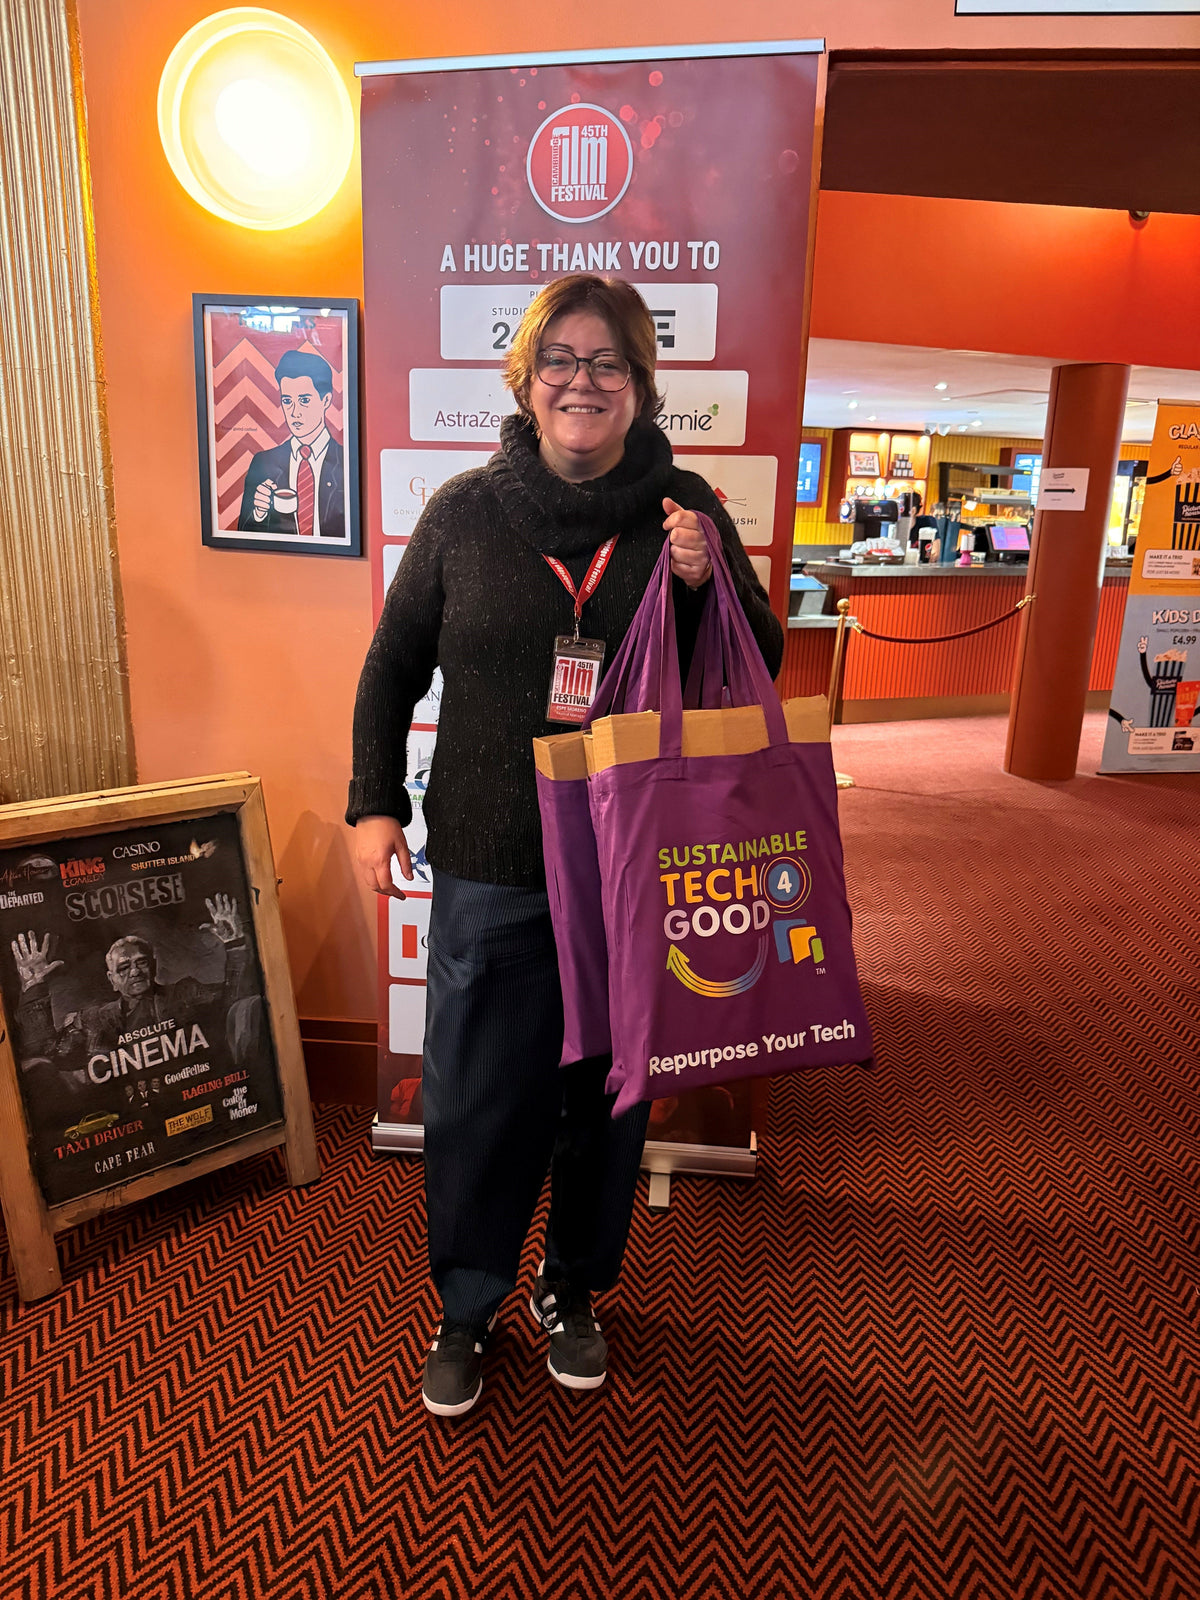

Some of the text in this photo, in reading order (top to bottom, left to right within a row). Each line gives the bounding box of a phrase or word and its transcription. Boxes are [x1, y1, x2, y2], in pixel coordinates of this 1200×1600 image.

[581, 124, 608, 137] 45TH
[551, 184, 608, 202] FESTIVAL
[440, 240, 720, 272] A HUGE THANK YOU TO
[655, 409, 712, 431] emie
[1167, 423, 1200, 440] CLA
[732, 517, 758, 526] USHI
[595, 557, 606, 569] Film
[585, 567, 601, 594] Festival
[1152, 608, 1189, 625] KIDS
[1172, 635, 1197, 645] £4.99
[577, 661, 594, 670] 45TH
[553, 693, 591, 706] FESTIVAL
[112, 840, 161, 859] CASINO
[658, 830, 808, 869] SUSTAINABLE
[60, 857, 105, 879] KING
[131, 852, 196, 871] SHUTTER ISLAND
[62, 873, 105, 888] COMEDY
[660, 864, 793, 906] TECH 4
[0, 891, 44, 910] DEPARTED
[65, 872, 185, 921] SCORSESE
[663, 900, 771, 941] GOOD
[815, 967, 827, 975] TM
[117, 1018, 176, 1045] ABSOLUTE
[87, 1023, 210, 1084] CINEMA
[649, 1019, 856, 1077] Repurpose Your Tech
[164, 1062, 210, 1085] GoodFellas
[181, 1069, 250, 1101] RAGING BULL
[232, 1085, 248, 1097] the
[168, 1106, 210, 1130] THE WOLF
[229, 1103, 258, 1120] Money
[53, 1119, 144, 1160] TAXI DRIVER
[94, 1141, 155, 1175] CAPE FEAR
